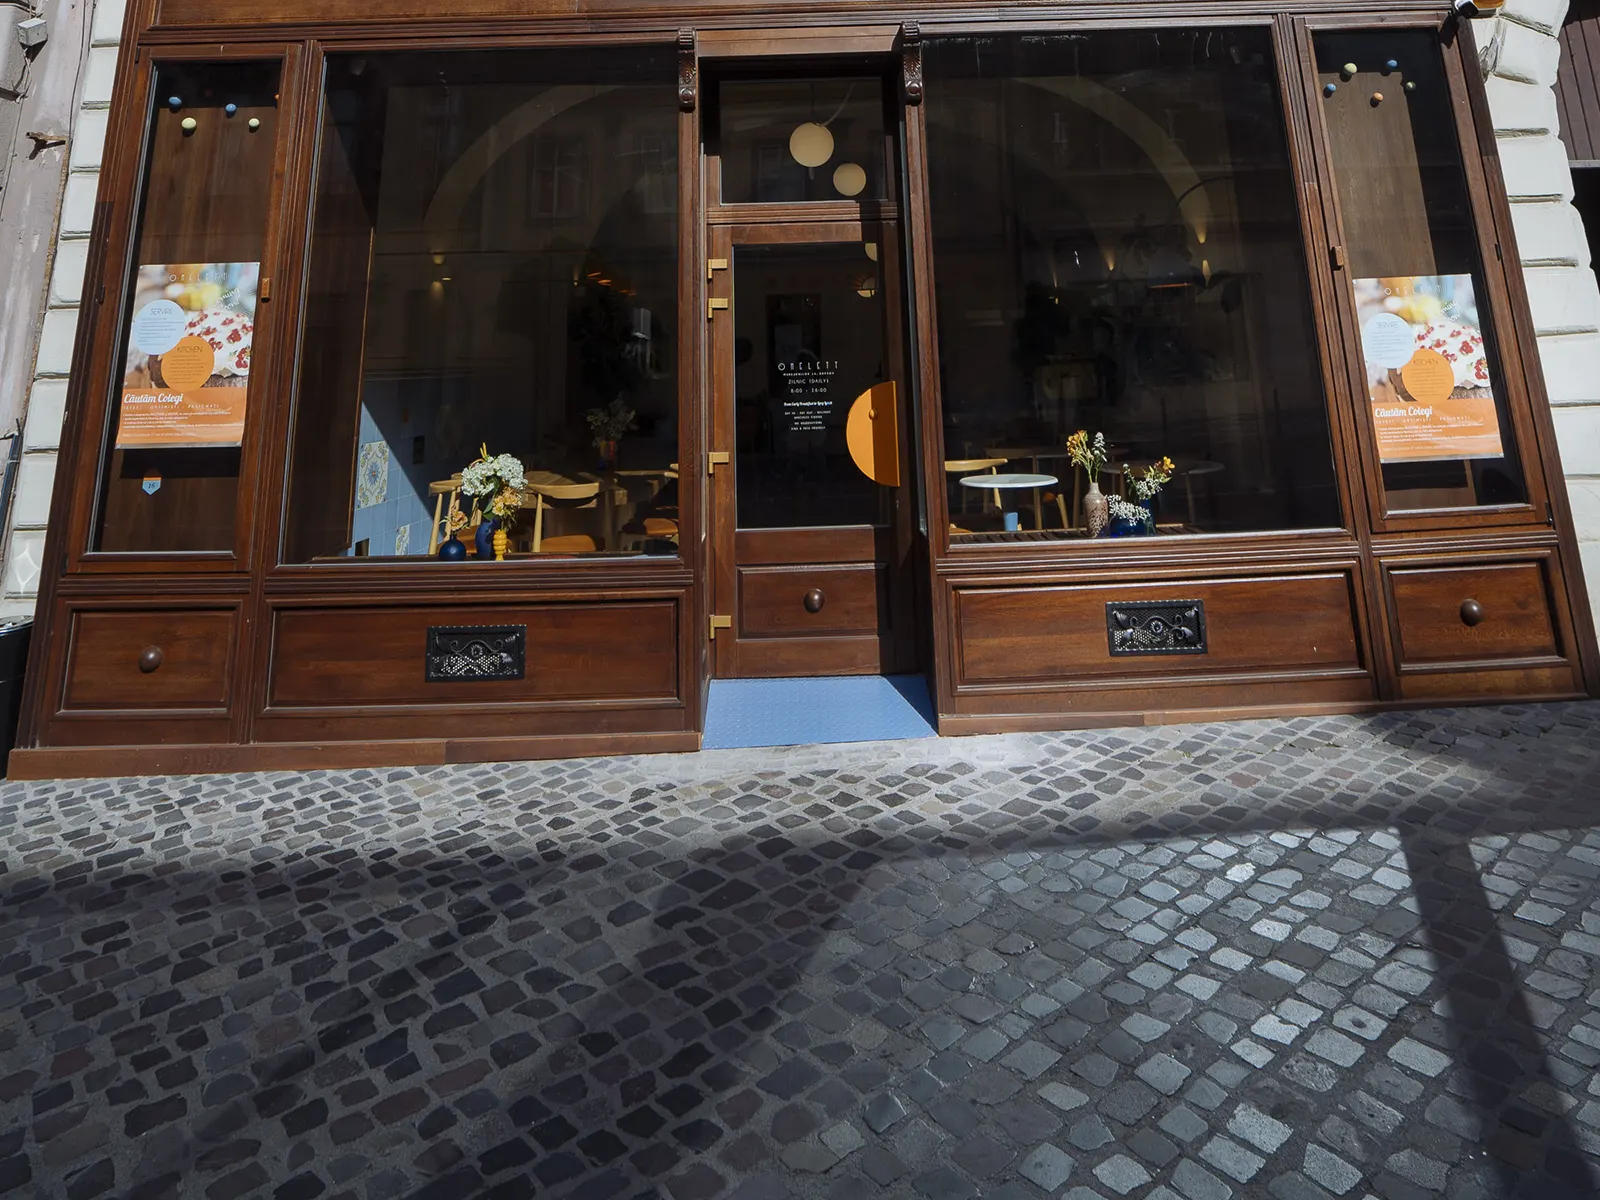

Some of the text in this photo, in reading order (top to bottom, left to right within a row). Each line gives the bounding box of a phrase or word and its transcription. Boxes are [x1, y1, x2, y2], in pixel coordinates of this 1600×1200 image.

[176, 345, 203, 354] KITCHEN
[1413, 358, 1439, 366] KITCHEN
[157, 393, 184, 405] Colegi
[1407, 406, 1433, 420] Colegi
